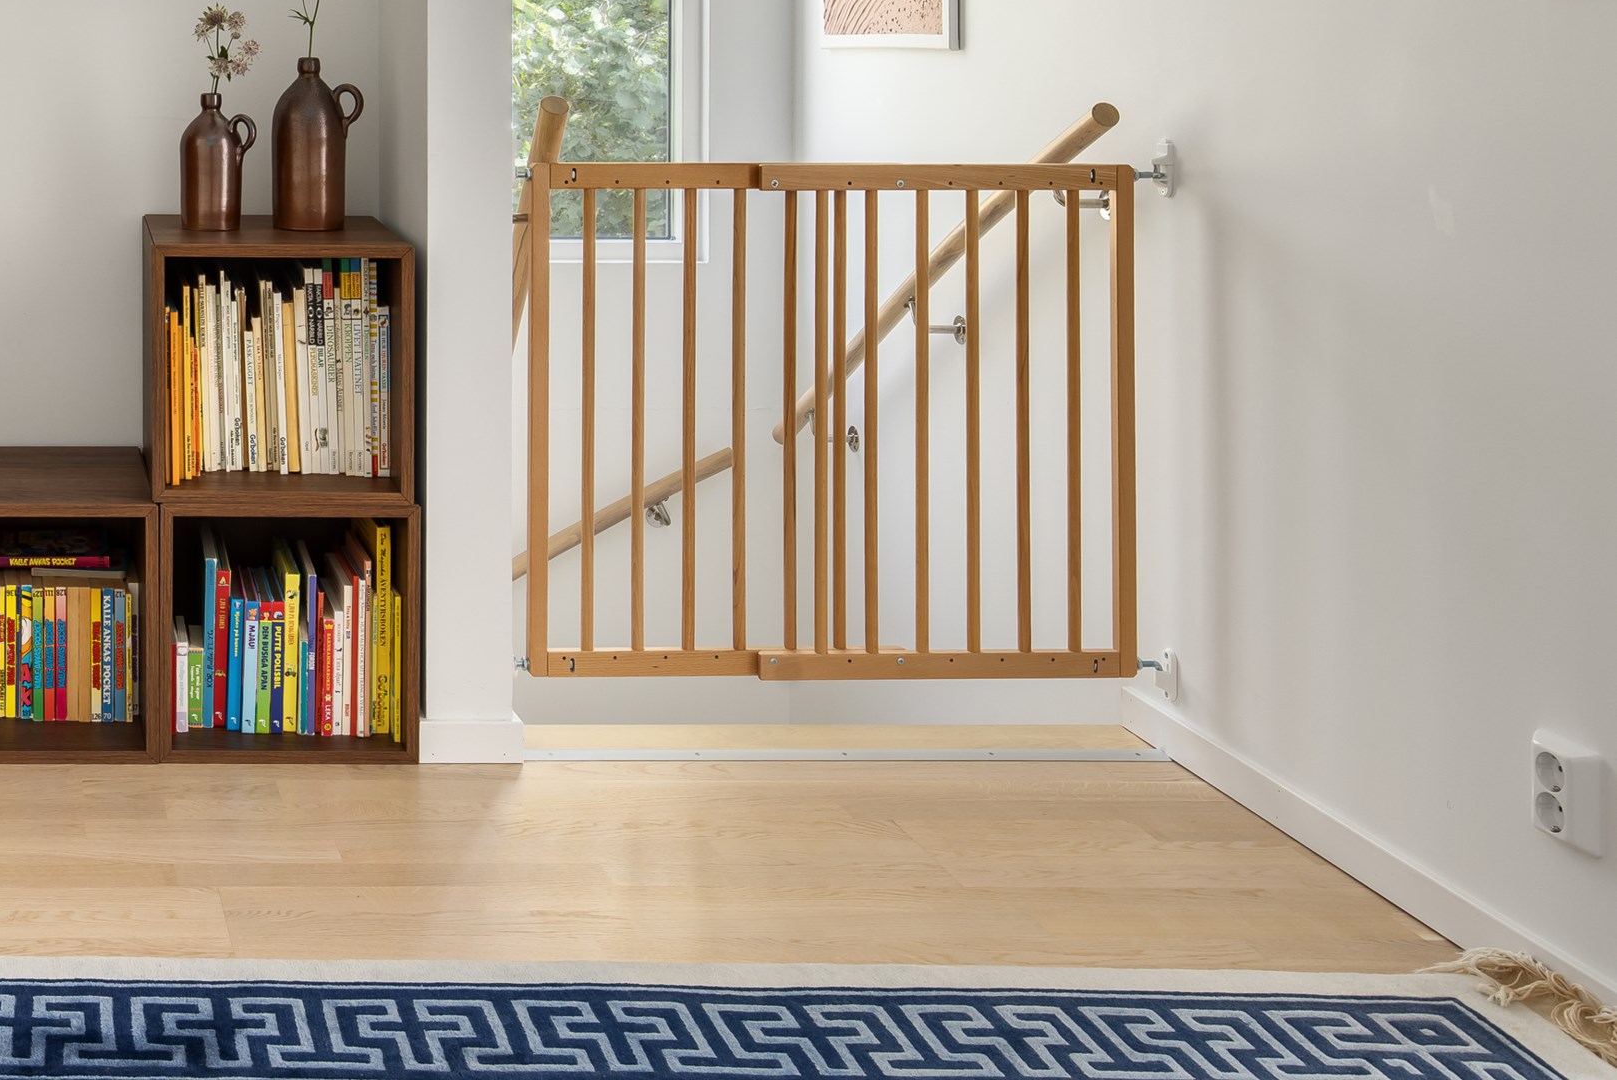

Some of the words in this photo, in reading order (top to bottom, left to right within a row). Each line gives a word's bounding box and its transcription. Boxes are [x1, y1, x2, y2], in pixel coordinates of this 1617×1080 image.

[344, 324, 352, 363] KROPPEN
[353, 324, 361, 345] LIVET
[326, 325, 335, 383] DINOSAURIER
[310, 347, 318, 396] FLYGMASKINER
[354, 358, 362, 396] VATTNET
[9, 558, 28, 566] KALLE
[29, 558, 50, 566] ANKAS
[52, 558, 76, 566] POCKET
[103, 595, 111, 626] KALLE
[34, 620, 42, 646] POCKET
[45, 619, 53, 645] POCKET
[57, 619, 65, 645] POCKET
[115, 621, 124, 646] POCKET
[274, 626, 282, 651] PUTTE
[45, 647, 53, 668] ANKAS
[57, 647, 65, 668] ANKAS
[103, 628, 111, 662] ANKAS
[261, 641, 269, 668] BUSIGA
[34, 647, 42, 669] ANKAS
[115, 648, 124, 670] ANKAS
[34, 671, 42, 689] KALLE
[45, 670, 53, 689] KALLE
[57, 669, 65, 688] KALLE
[103, 665, 111, 704] POCKET
[115, 671, 124, 690] KALLE
[377, 675, 388, 727] Go'boken
